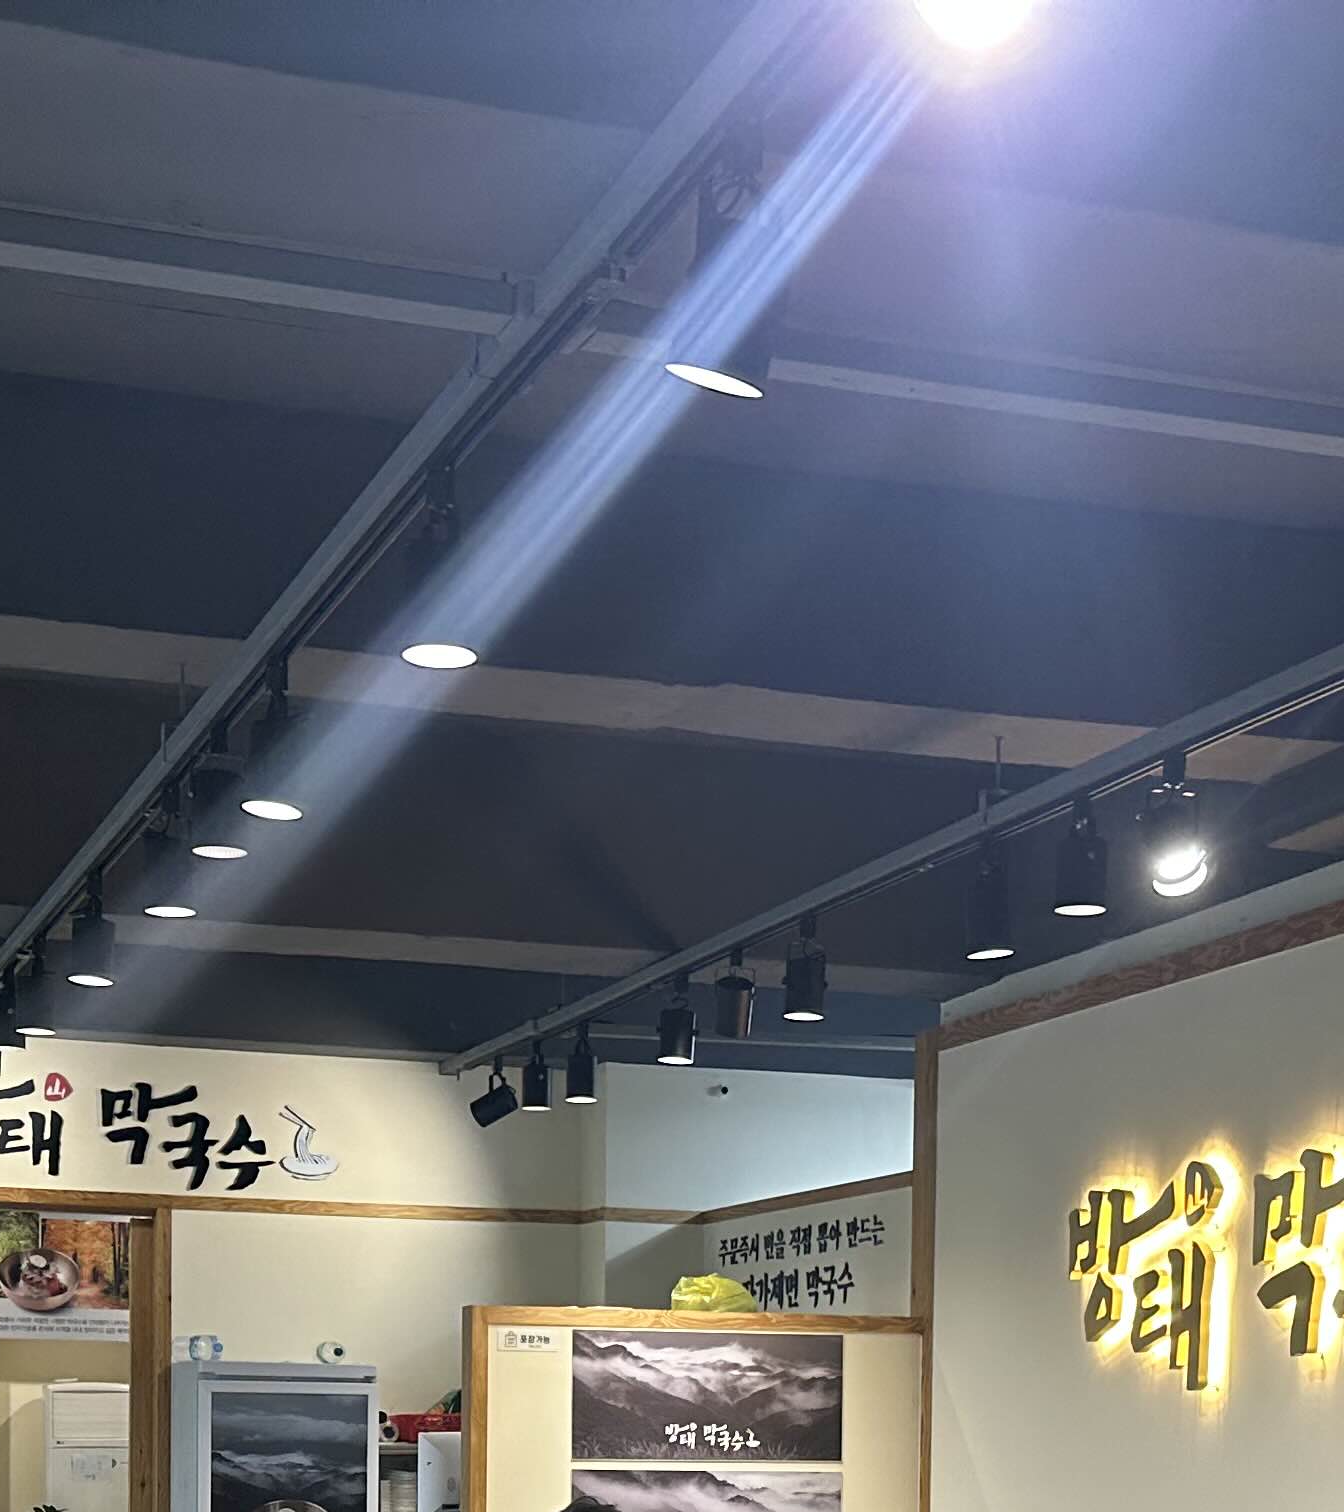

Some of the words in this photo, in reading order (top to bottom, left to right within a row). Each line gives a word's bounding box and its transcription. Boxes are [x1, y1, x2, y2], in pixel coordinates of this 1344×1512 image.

[100, 1082, 276, 1191] 막국수
[719, 1233, 760, 1267] 주문즉시
[763, 1228, 786, 1260] 면을
[789, 1224, 812, 1256] 직접
[846, 1214, 885, 1248] 만드는
[806, 1262, 855, 1308] 막국수
[1068, 1178, 1214, 1391] 방태
[703, 1423, 745, 1451] 막국수
